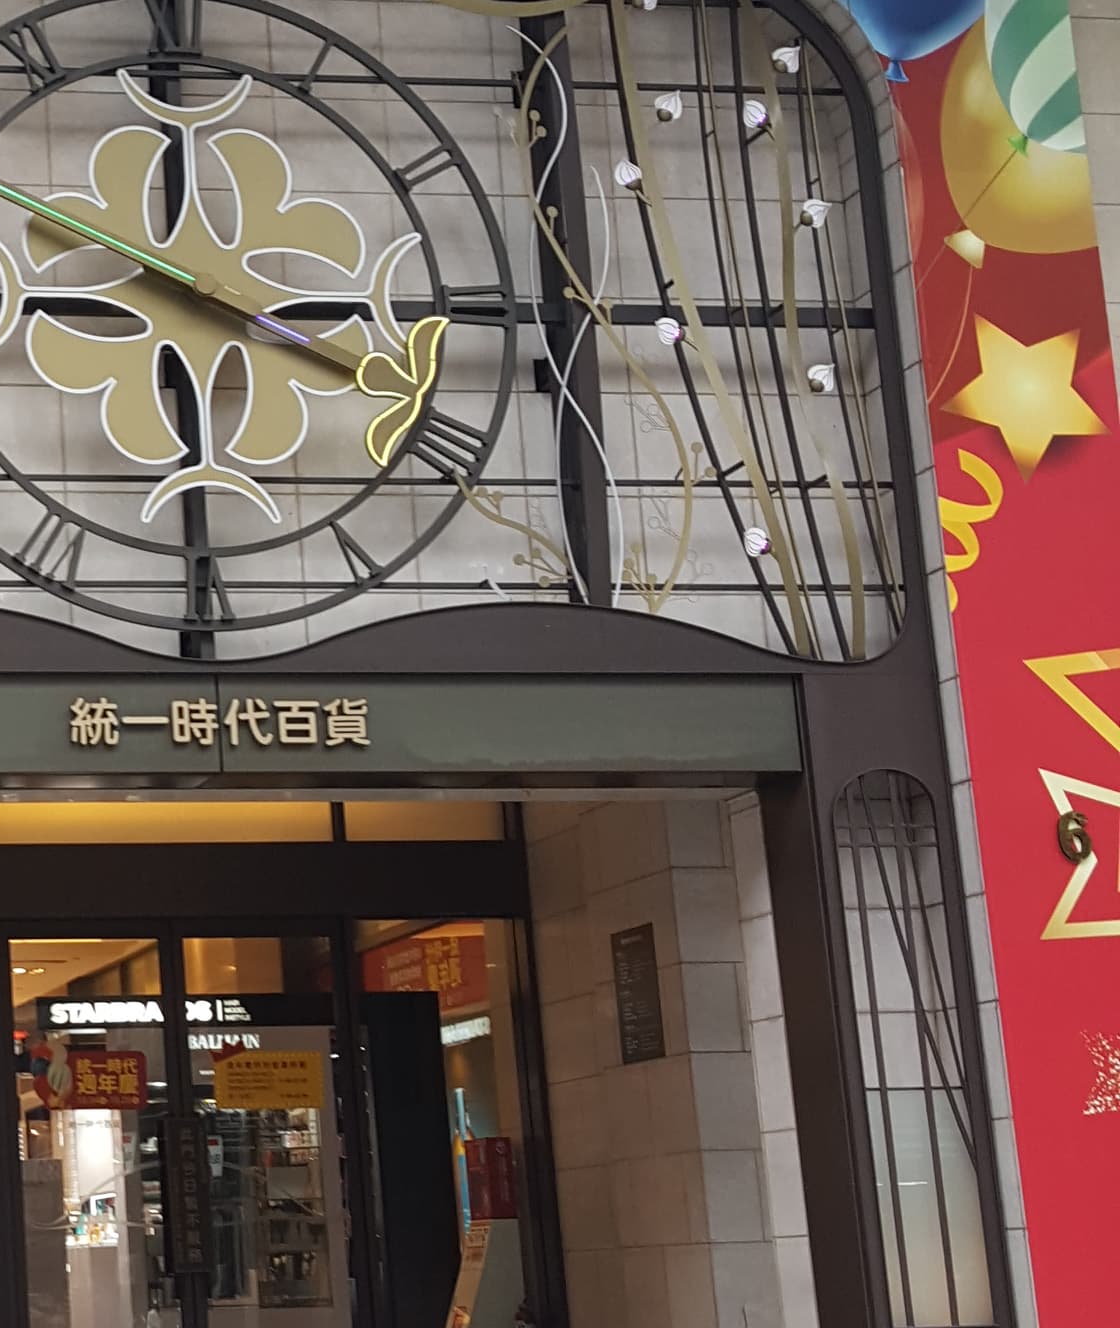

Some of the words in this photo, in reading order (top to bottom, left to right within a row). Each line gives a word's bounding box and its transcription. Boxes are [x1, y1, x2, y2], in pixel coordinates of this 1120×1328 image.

[69, 696, 372, 747] 統一時代百貨
[1056, 811, 1092, 866] 6
